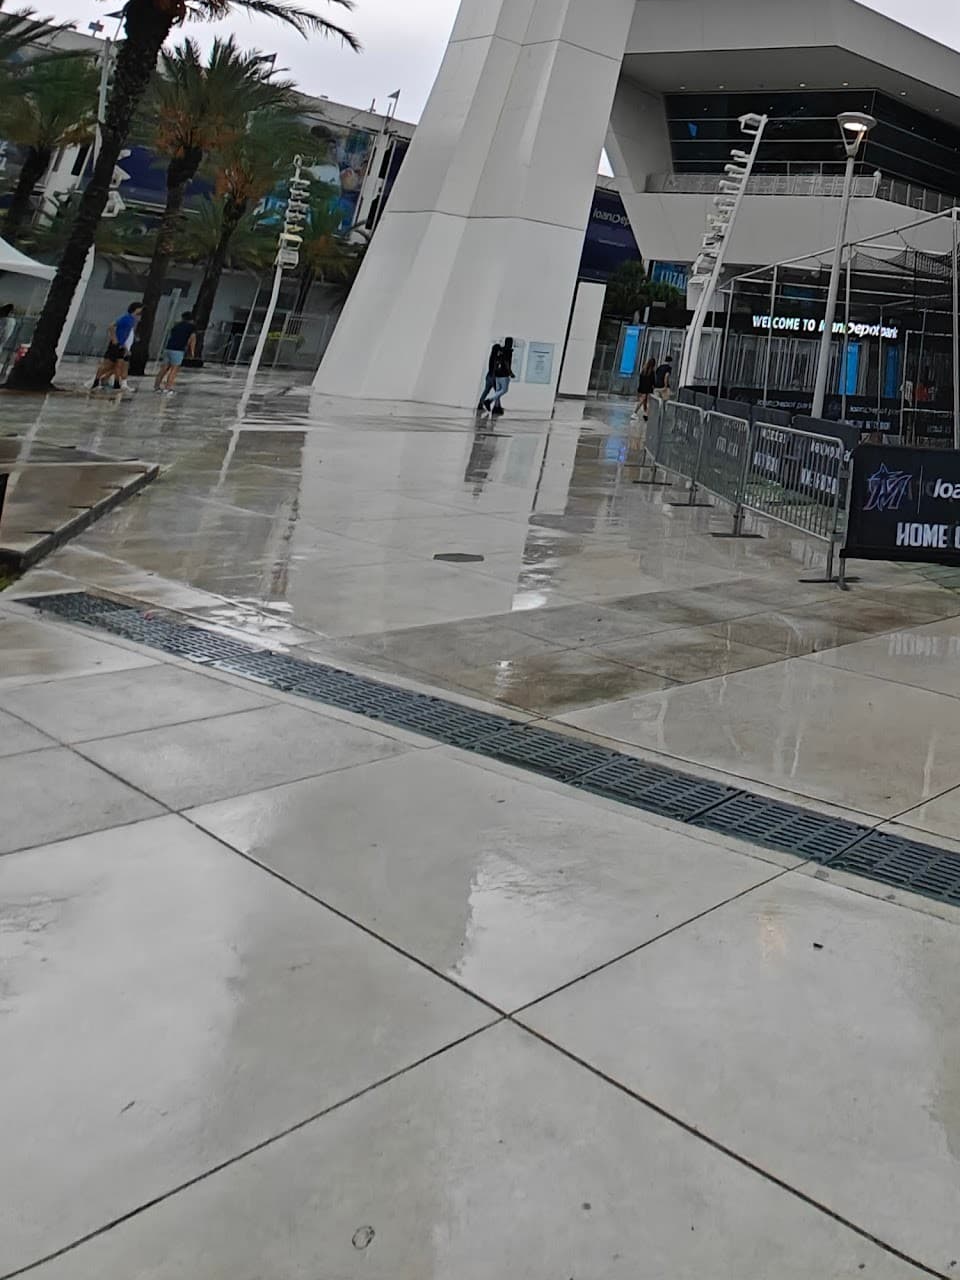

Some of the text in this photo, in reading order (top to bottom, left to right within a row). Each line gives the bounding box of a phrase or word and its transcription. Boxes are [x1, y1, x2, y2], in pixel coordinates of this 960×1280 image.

[752, 315, 800, 330] WELCOME
[802, 318, 816, 332] TO
[879, 326, 898, 339] park
[896, 522, 949, 548] HOME
